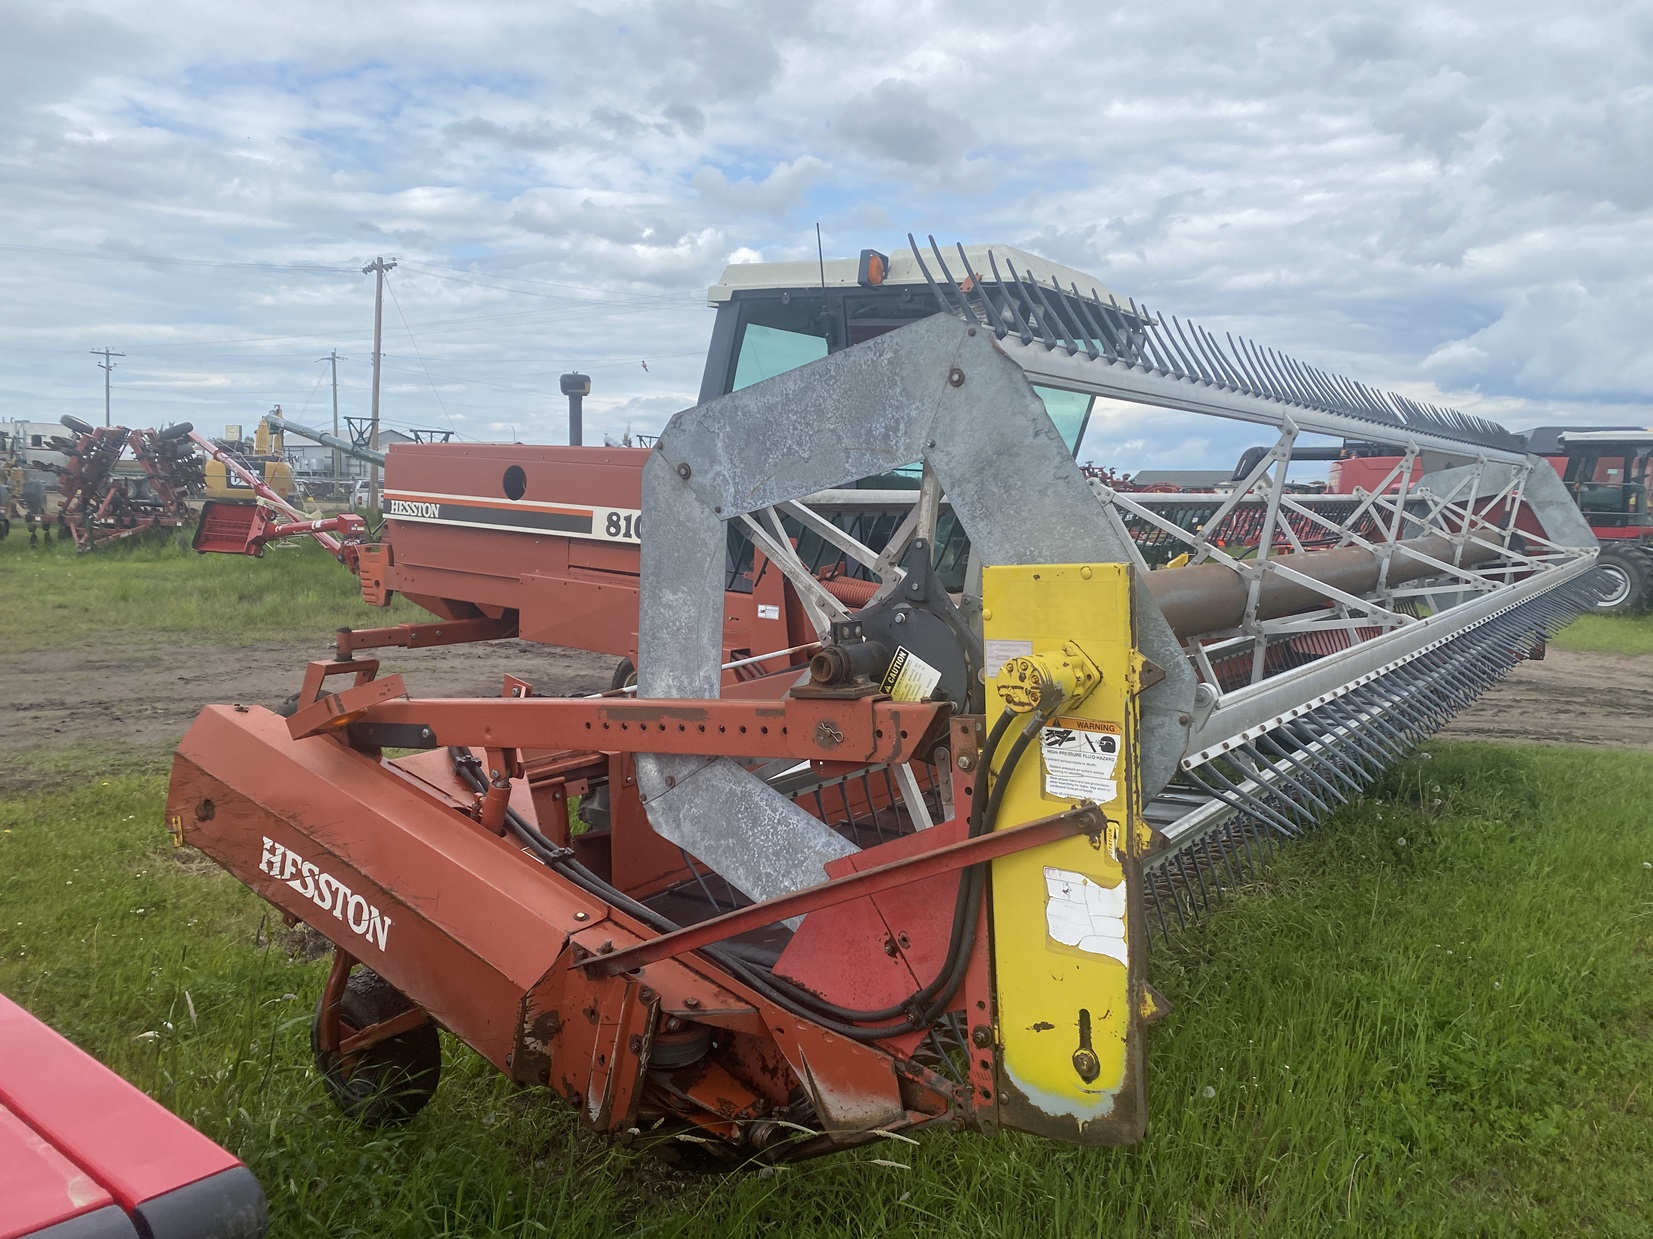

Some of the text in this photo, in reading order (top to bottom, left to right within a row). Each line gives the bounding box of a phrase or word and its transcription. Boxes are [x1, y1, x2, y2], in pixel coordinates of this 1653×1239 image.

[390, 500, 440, 518] HESSTON
[887, 650, 907, 684] CAUTION
[1076, 721, 1115, 732] WARNING
[259, 835, 392, 952] HESSTON
